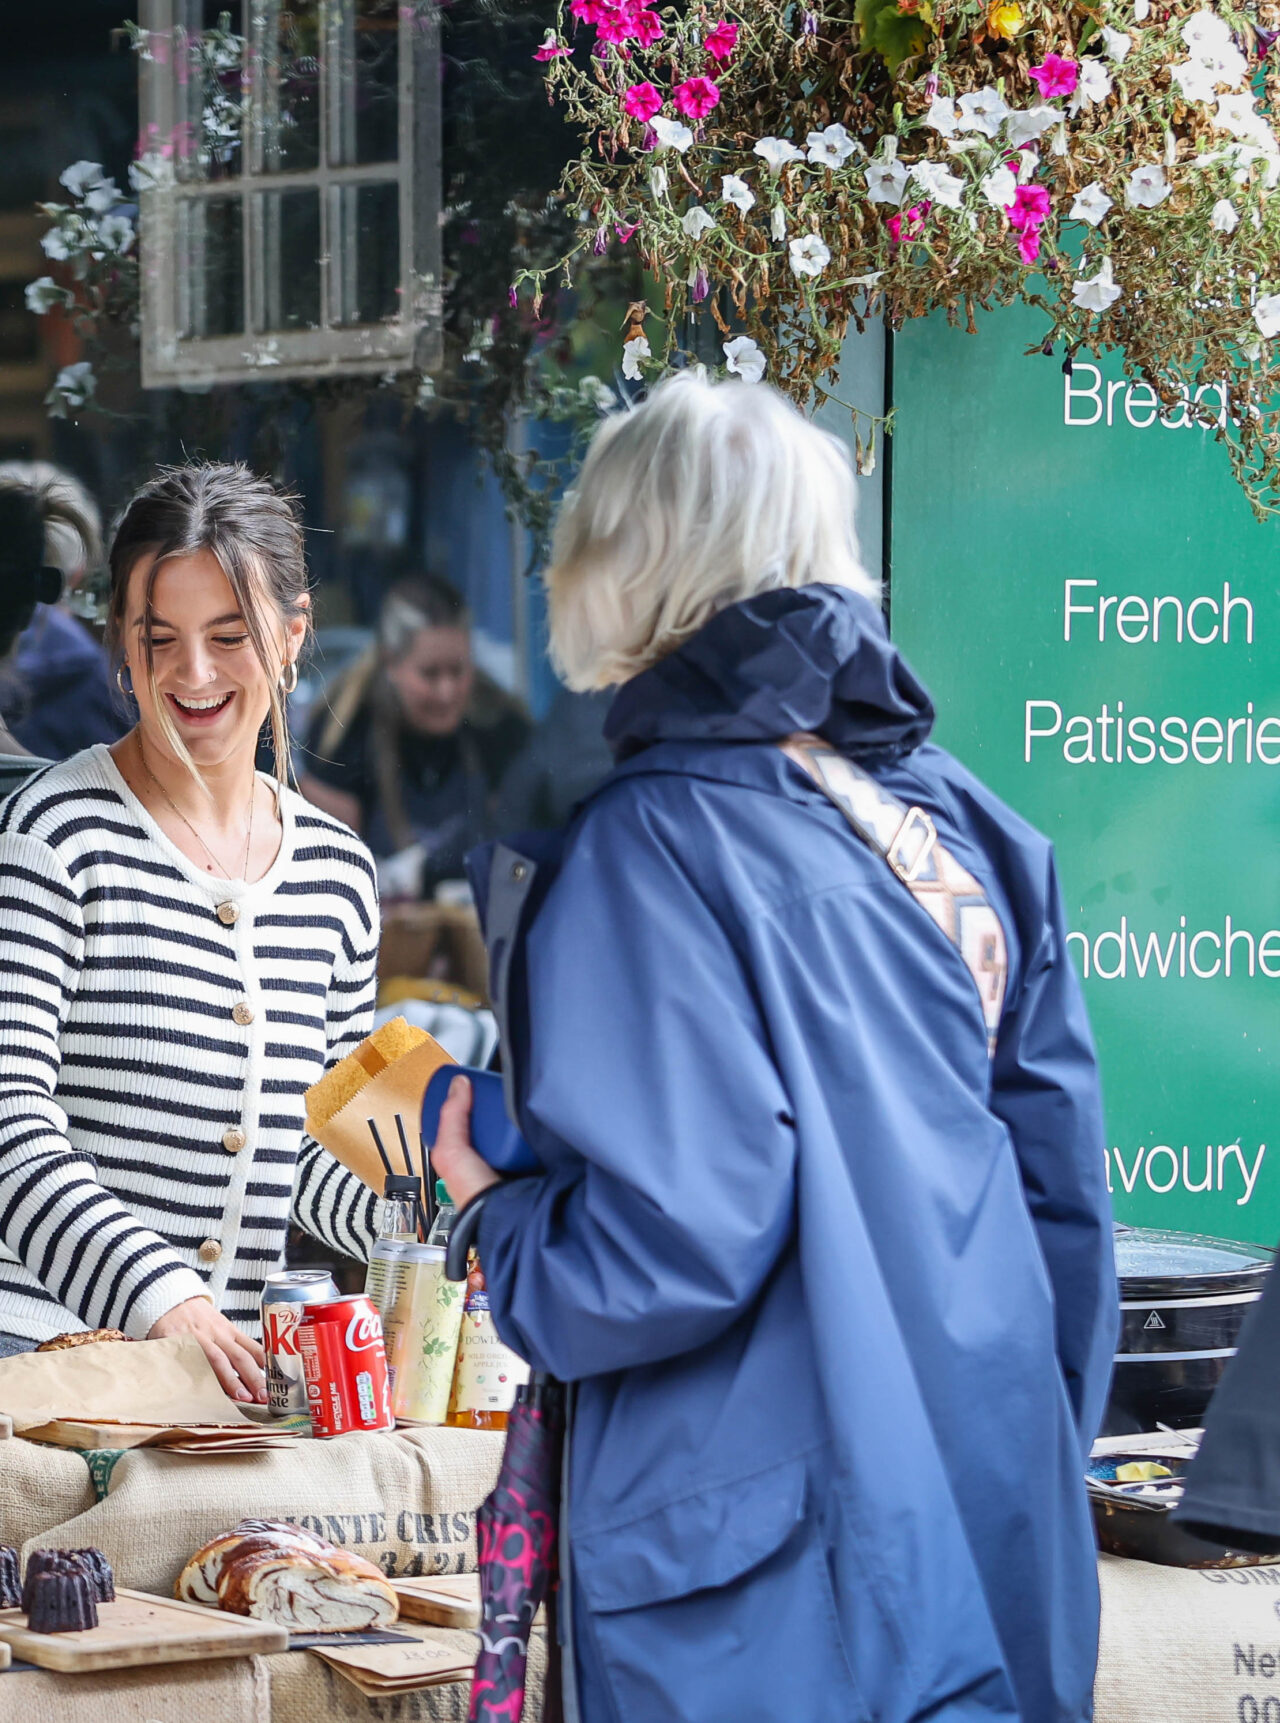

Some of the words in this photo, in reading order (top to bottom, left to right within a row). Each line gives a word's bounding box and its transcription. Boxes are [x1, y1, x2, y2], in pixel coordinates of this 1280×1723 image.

[1064, 578, 1254, 645] French
[1024, 699, 1280, 765] Patisserie
[278, 1310, 299, 1323] Di
[1233, 1643, 1280, 1678] Ne
